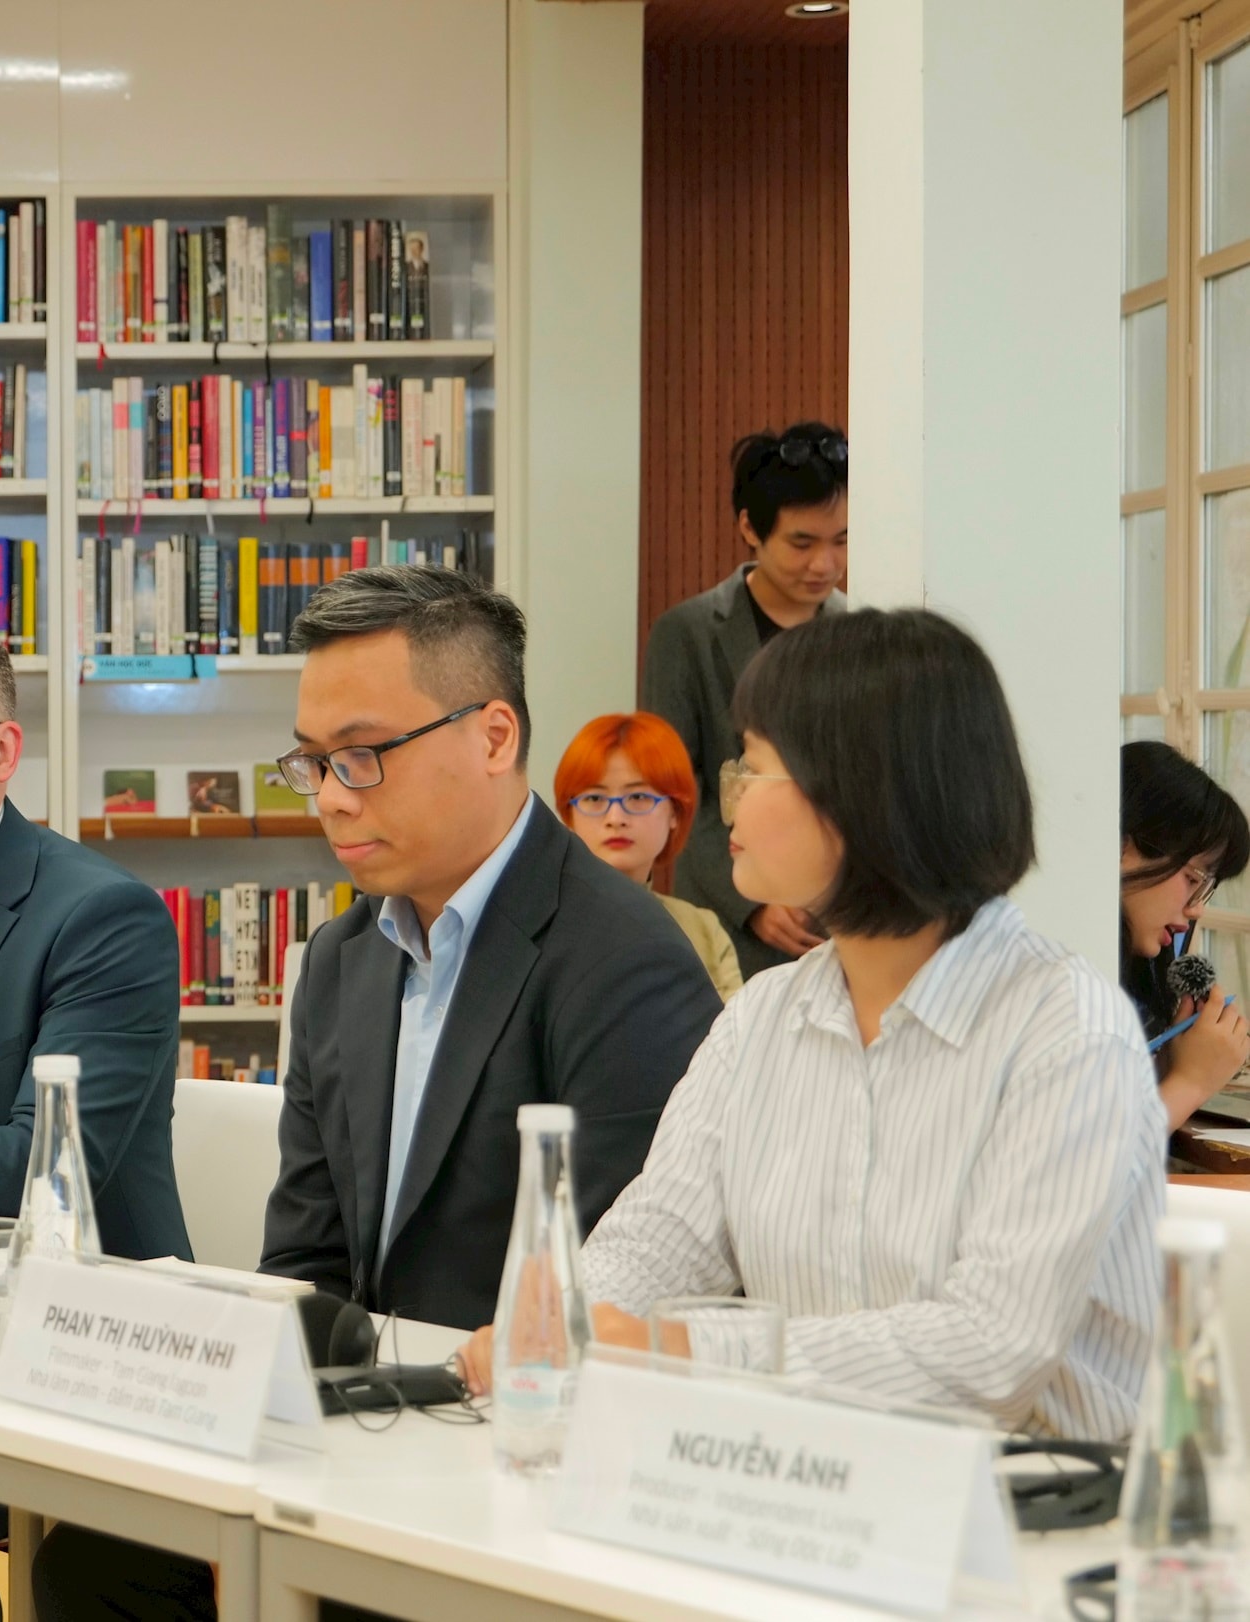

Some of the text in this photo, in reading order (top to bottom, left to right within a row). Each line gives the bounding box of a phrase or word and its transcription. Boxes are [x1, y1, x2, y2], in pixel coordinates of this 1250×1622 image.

[43, 1304, 236, 1370] PHAN THỊ HUỲNH NHI
[669, 1430, 778, 1480] NGUYỄN
